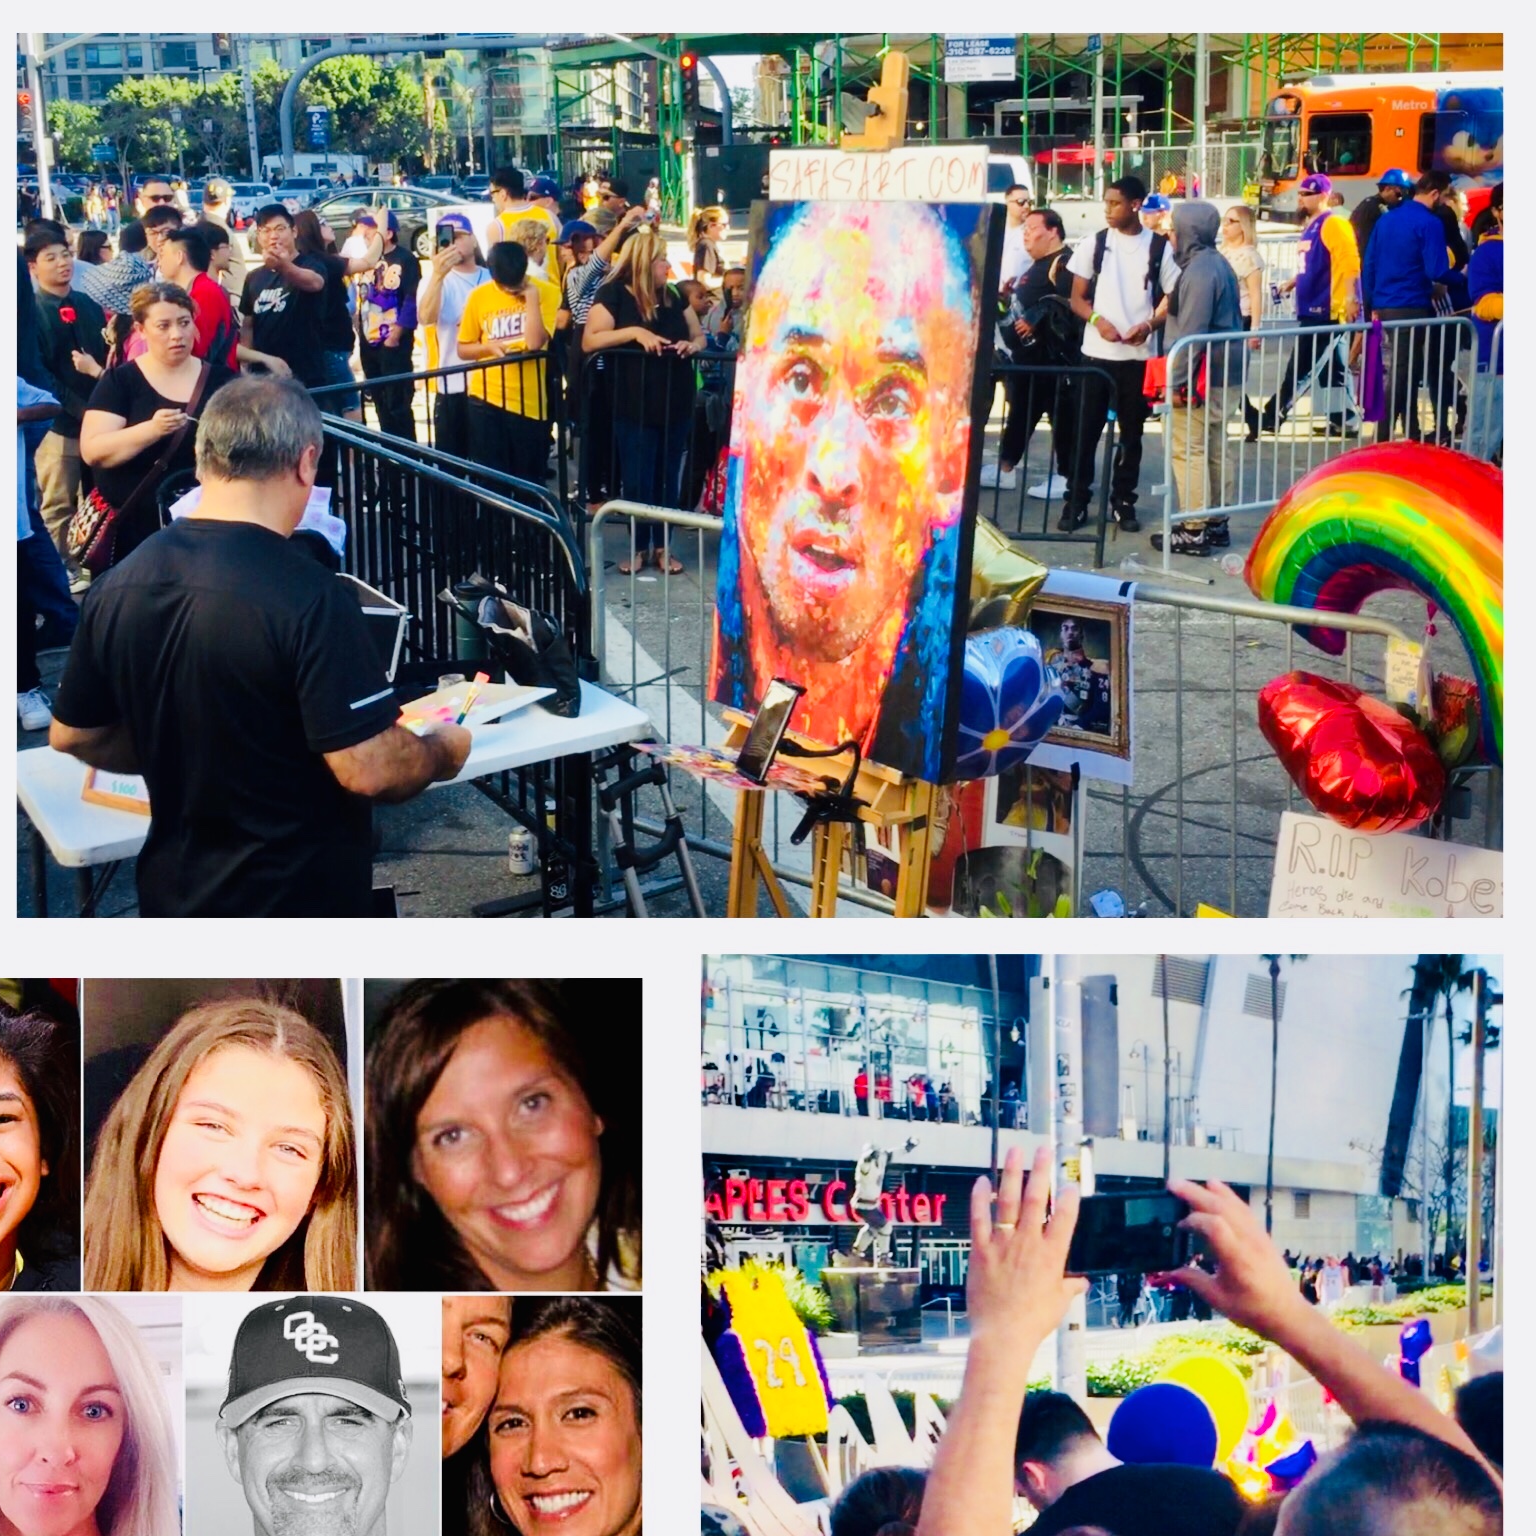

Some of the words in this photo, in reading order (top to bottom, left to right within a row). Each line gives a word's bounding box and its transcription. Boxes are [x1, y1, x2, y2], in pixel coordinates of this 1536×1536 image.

[949, 40, 964, 48] FOR
[966, 40, 990, 48] LEASE
[1392, 100, 1427, 111] Metro
[1400, 846, 1496, 915] Kobe
